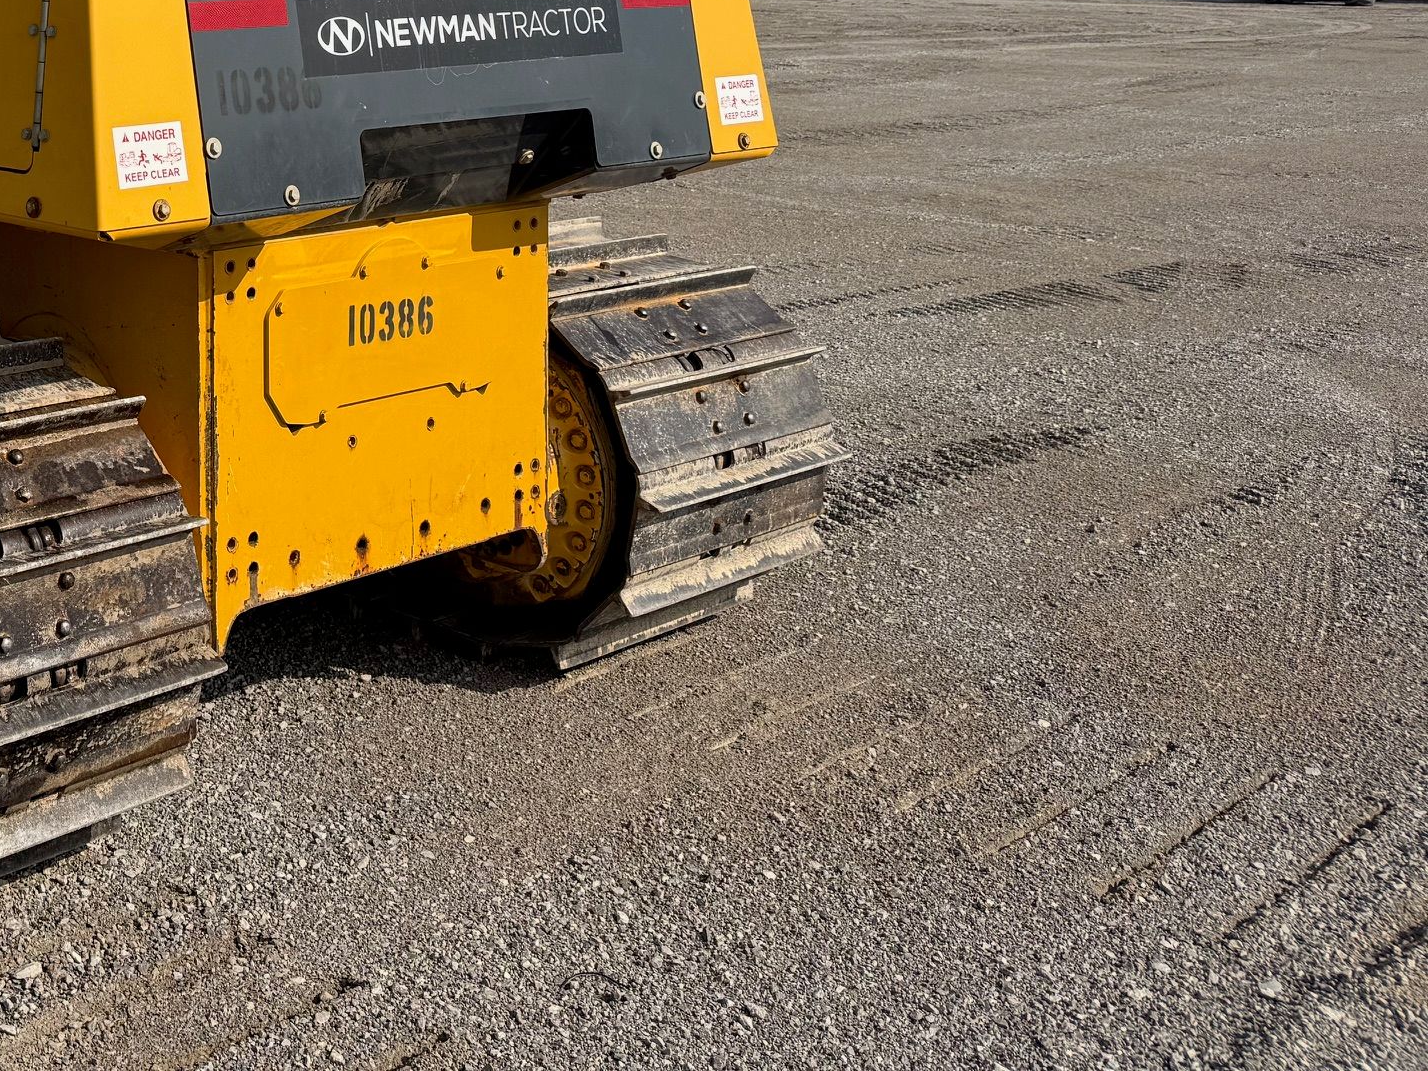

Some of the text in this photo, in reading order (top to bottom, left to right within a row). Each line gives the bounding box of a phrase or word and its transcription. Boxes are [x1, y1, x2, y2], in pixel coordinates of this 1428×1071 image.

[728, 79, 755, 90] DANGER
[724, 109, 759, 120] KEEP CLEAR
[133, 128, 176, 143] DANGER
[124, 167, 181, 183] KEEP CLEAR
[348, 295, 434, 347] 10386
